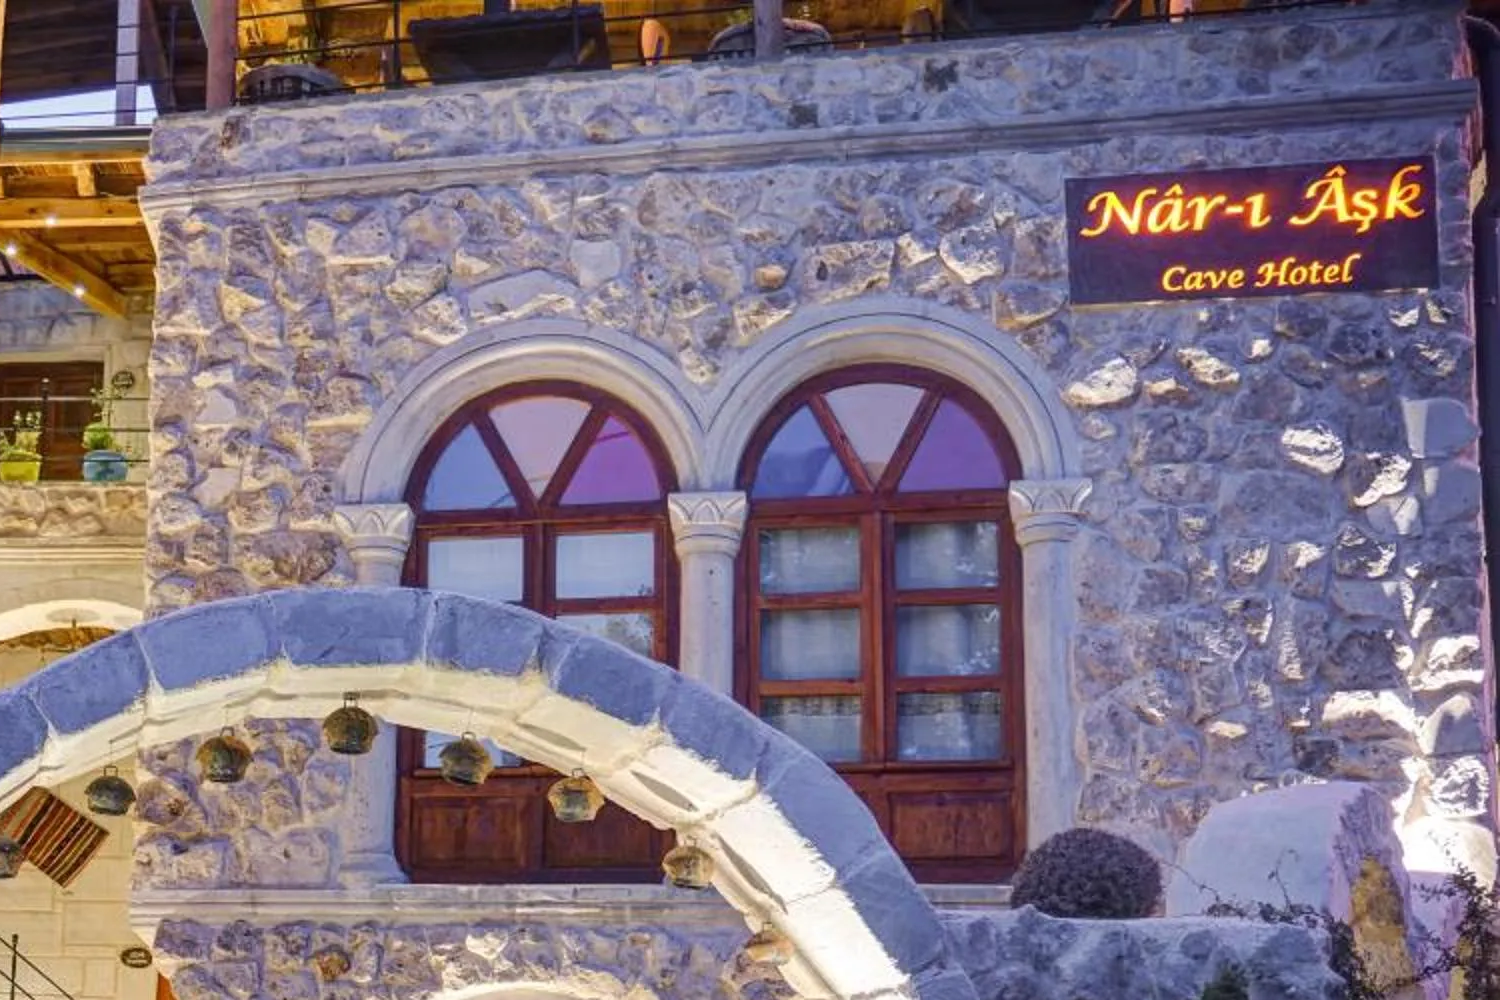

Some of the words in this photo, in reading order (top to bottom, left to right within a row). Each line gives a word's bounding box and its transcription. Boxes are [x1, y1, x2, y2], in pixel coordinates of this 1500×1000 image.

[1080, 184, 1271, 236] Nâr-ı
[1288, 164, 1424, 233] Âşk
[1161, 266, 1244, 292] Cave
[1255, 253, 1361, 287] Hotel
